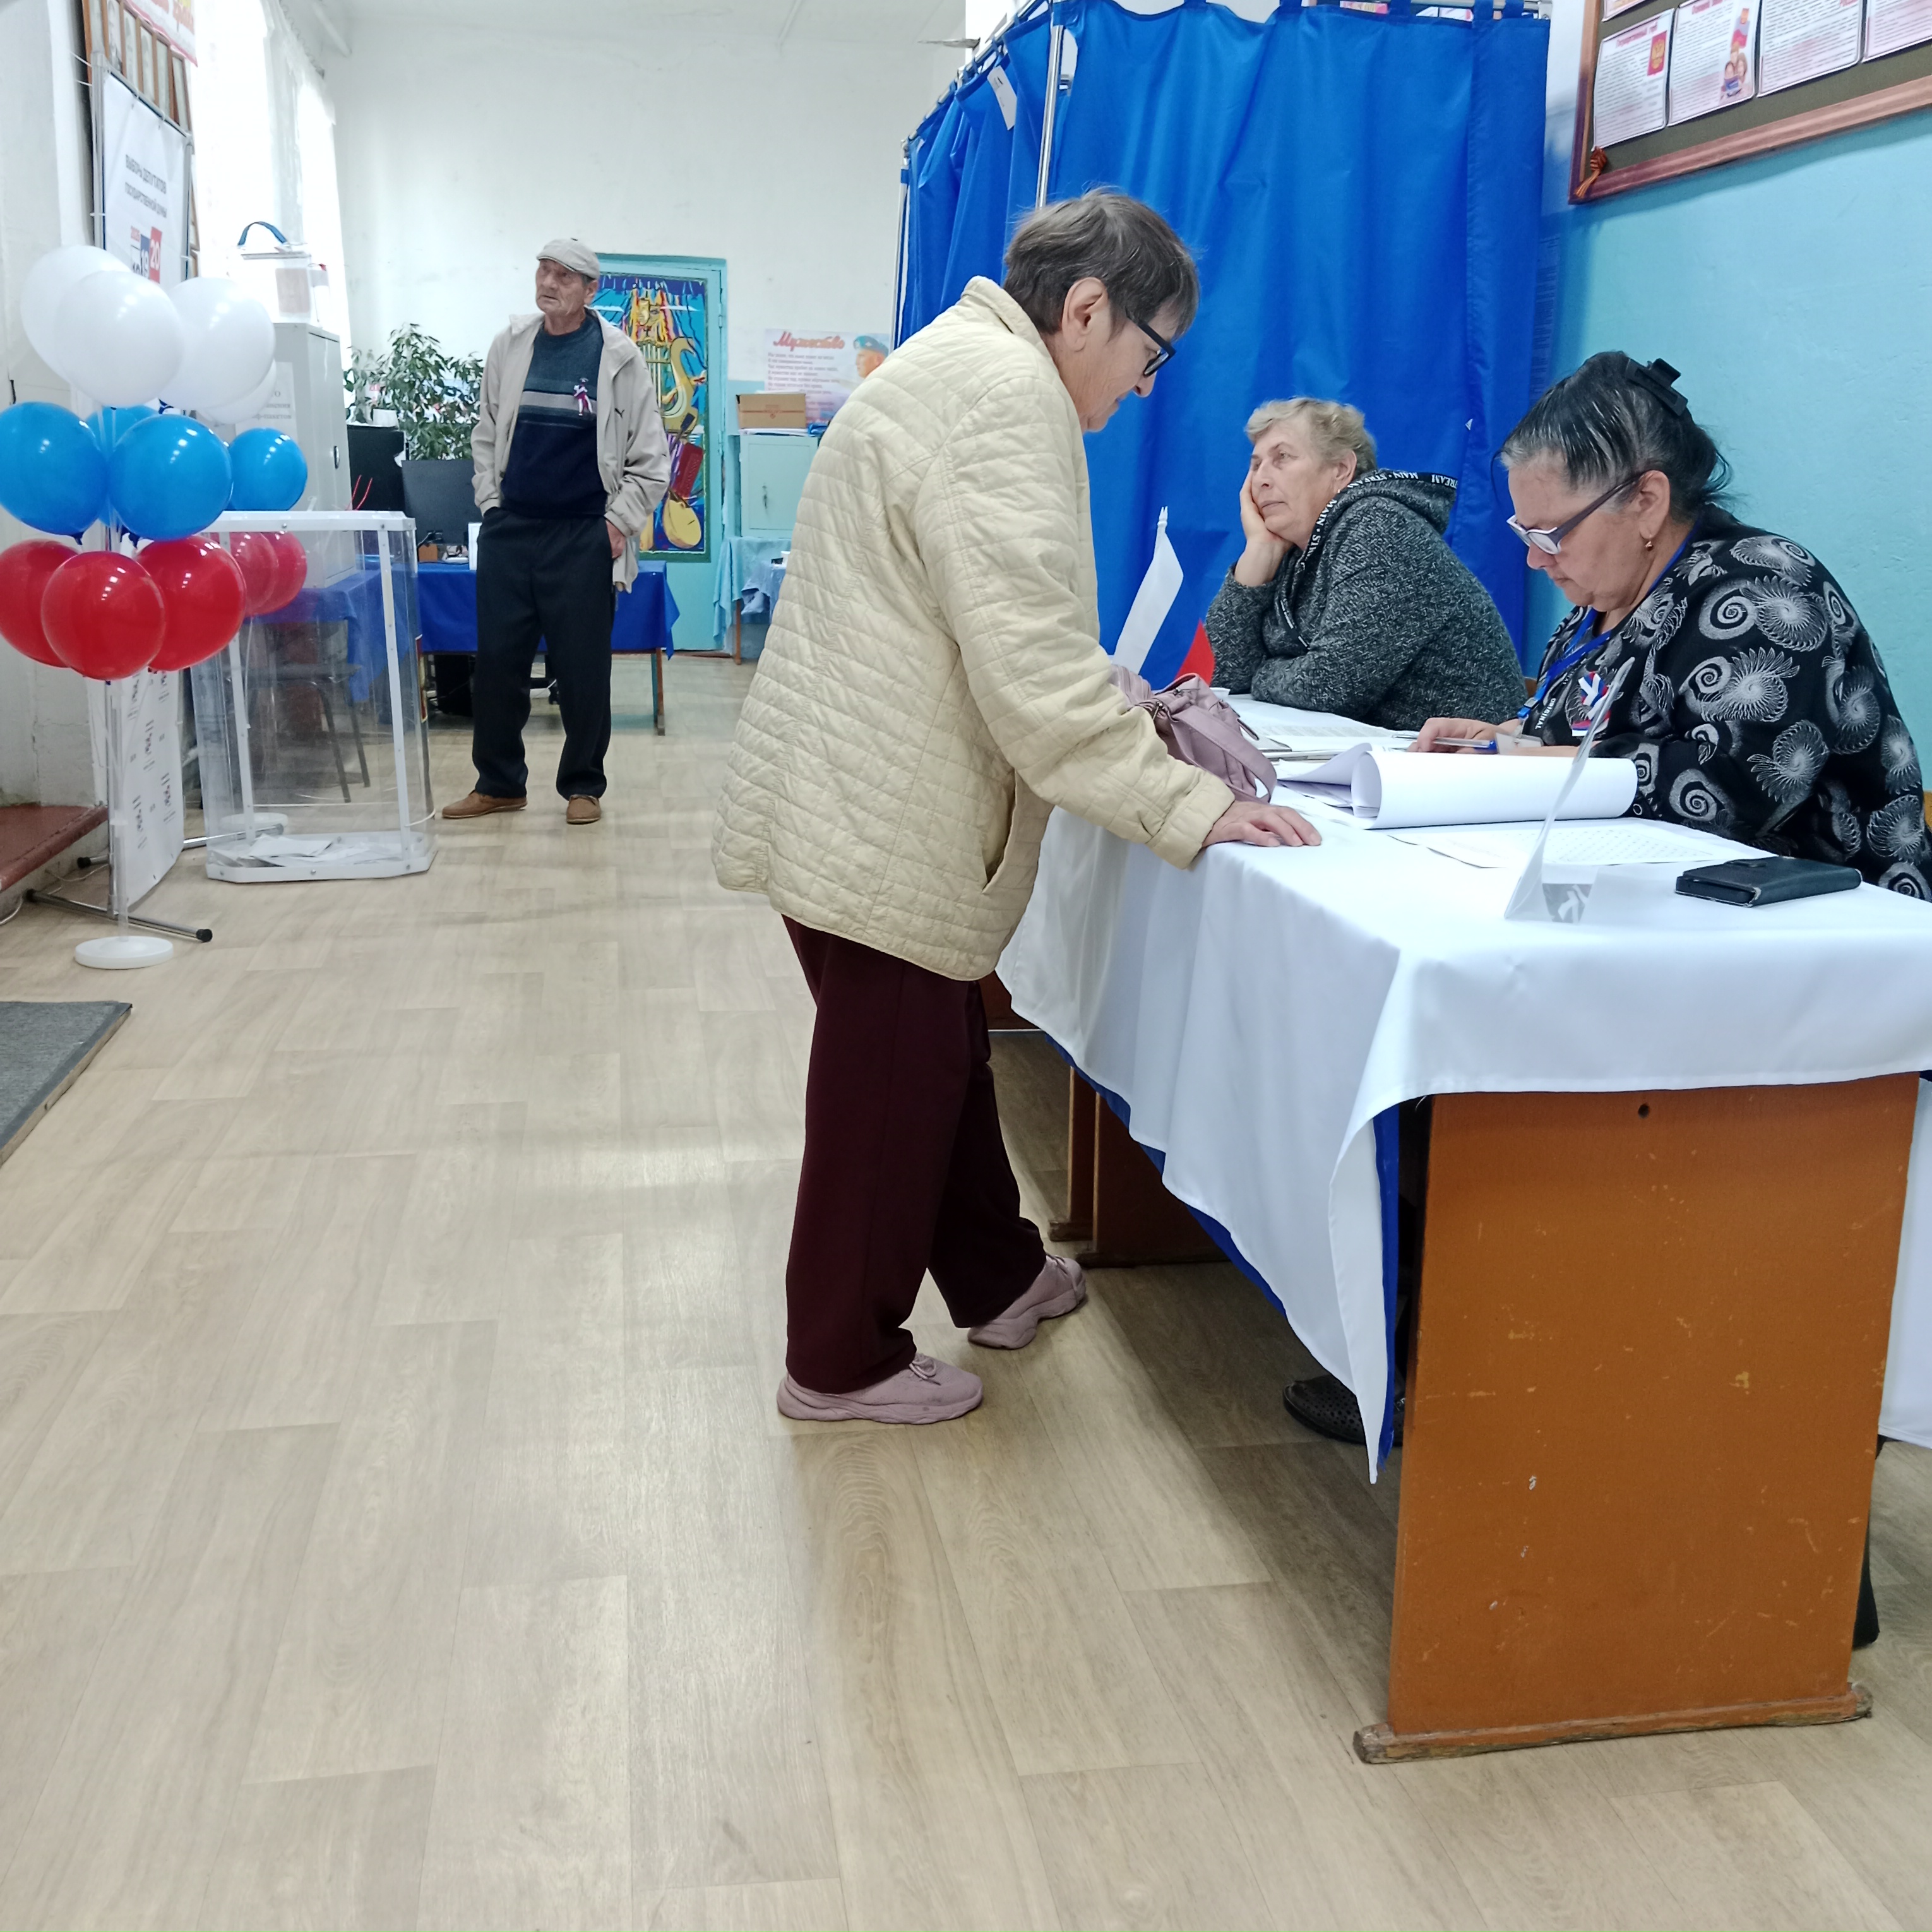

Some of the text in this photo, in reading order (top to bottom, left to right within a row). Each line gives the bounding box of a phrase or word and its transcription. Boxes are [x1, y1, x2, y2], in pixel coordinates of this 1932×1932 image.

[150, 239, 160, 271] 20
[1431, 474, 1458, 489] TREAM
[1316, 499, 1337, 526] MAIN
[1534, 698, 1556, 730] ORIGINAL
